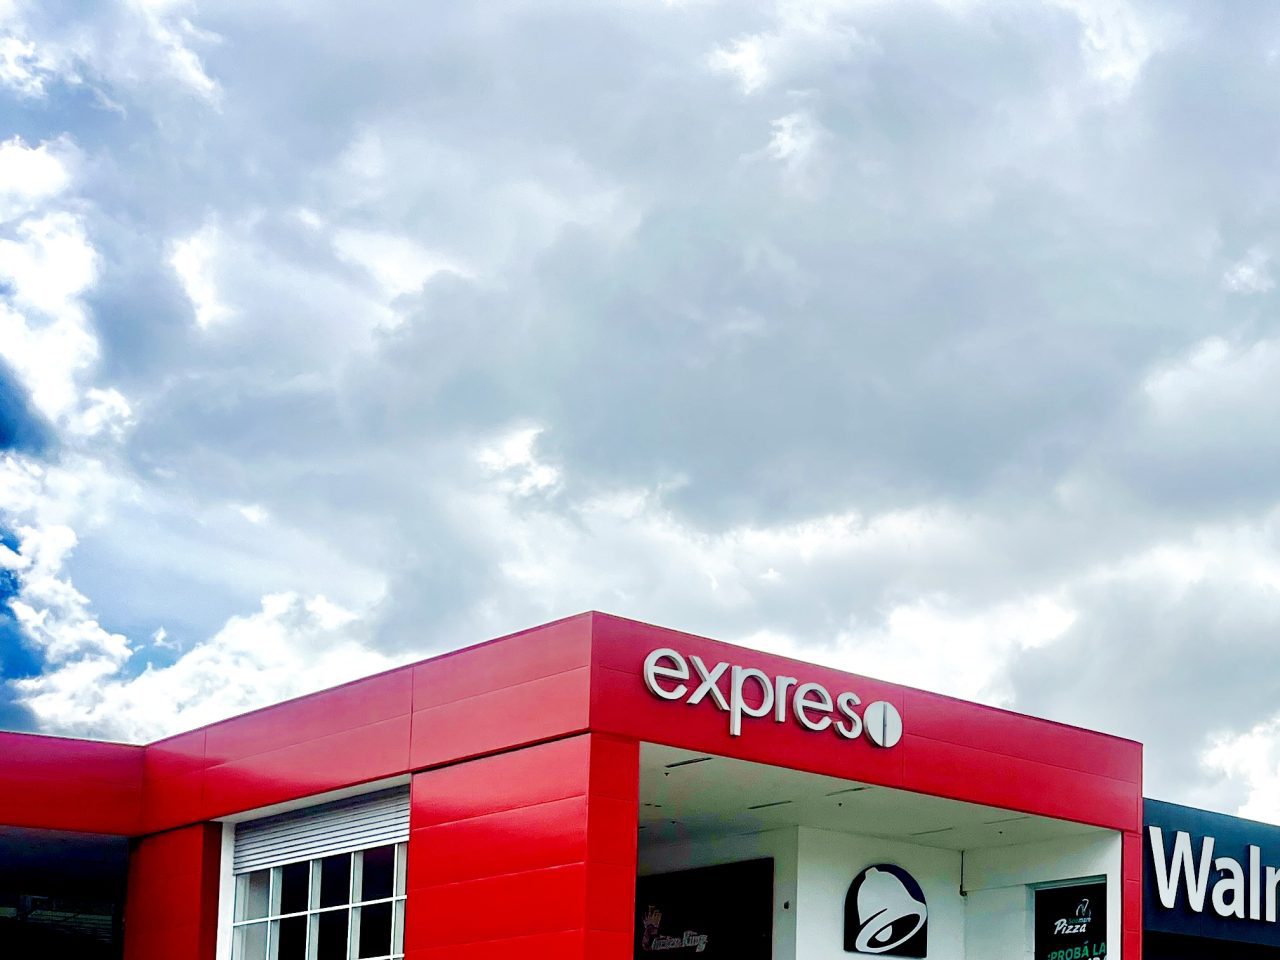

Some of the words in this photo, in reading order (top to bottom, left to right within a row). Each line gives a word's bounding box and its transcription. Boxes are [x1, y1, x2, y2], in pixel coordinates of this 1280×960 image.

[643, 648, 903, 748] expreso
[1054, 918, 1087, 935] Pizza
[1092, 942, 1107, 956] LA
